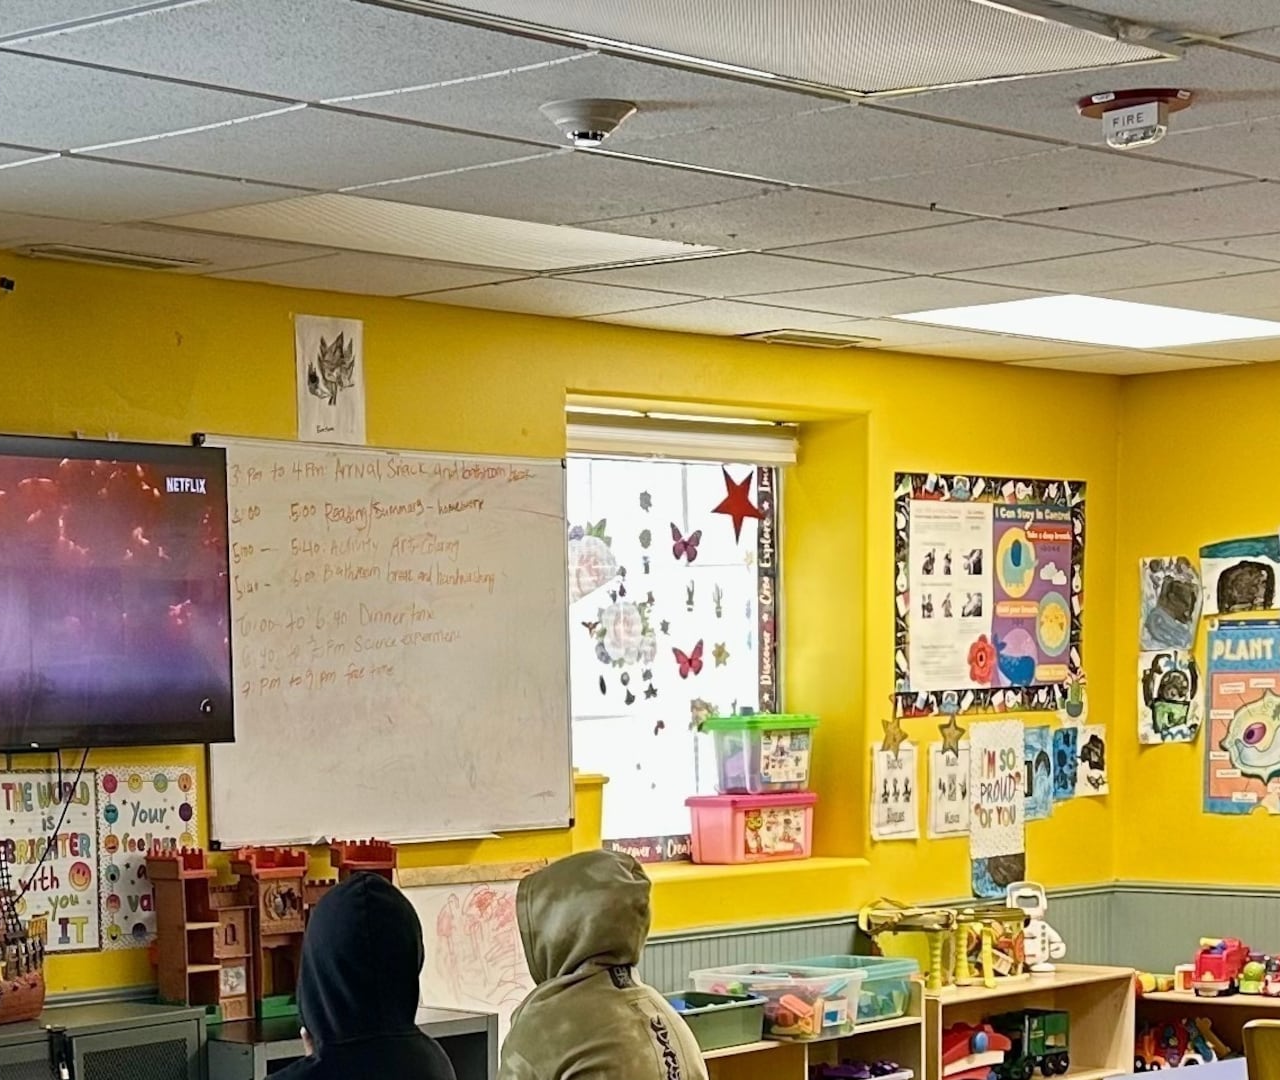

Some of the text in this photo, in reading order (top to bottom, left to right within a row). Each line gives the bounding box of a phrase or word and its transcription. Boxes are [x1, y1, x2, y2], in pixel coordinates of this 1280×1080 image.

[1113, 112, 1144, 128] FIRE
[166, 477, 207, 494] NETFLIX
[1212, 638, 1274, 661] PLANT
[980, 747, 1016, 779] I'M SO
[1, 780, 90, 812] THE WORLD
[980, 773, 1016, 803] PROUD
[41, 811, 56, 832] is
[130, 801, 167, 827] Your
[980, 807, 993, 828] OF
[996, 804, 1016, 827] YOU
[2, 832, 91, 865] BRIGHTER
[19, 866, 60, 892] with
[48, 893, 79, 922] you
[58, 916, 89, 944] IT
